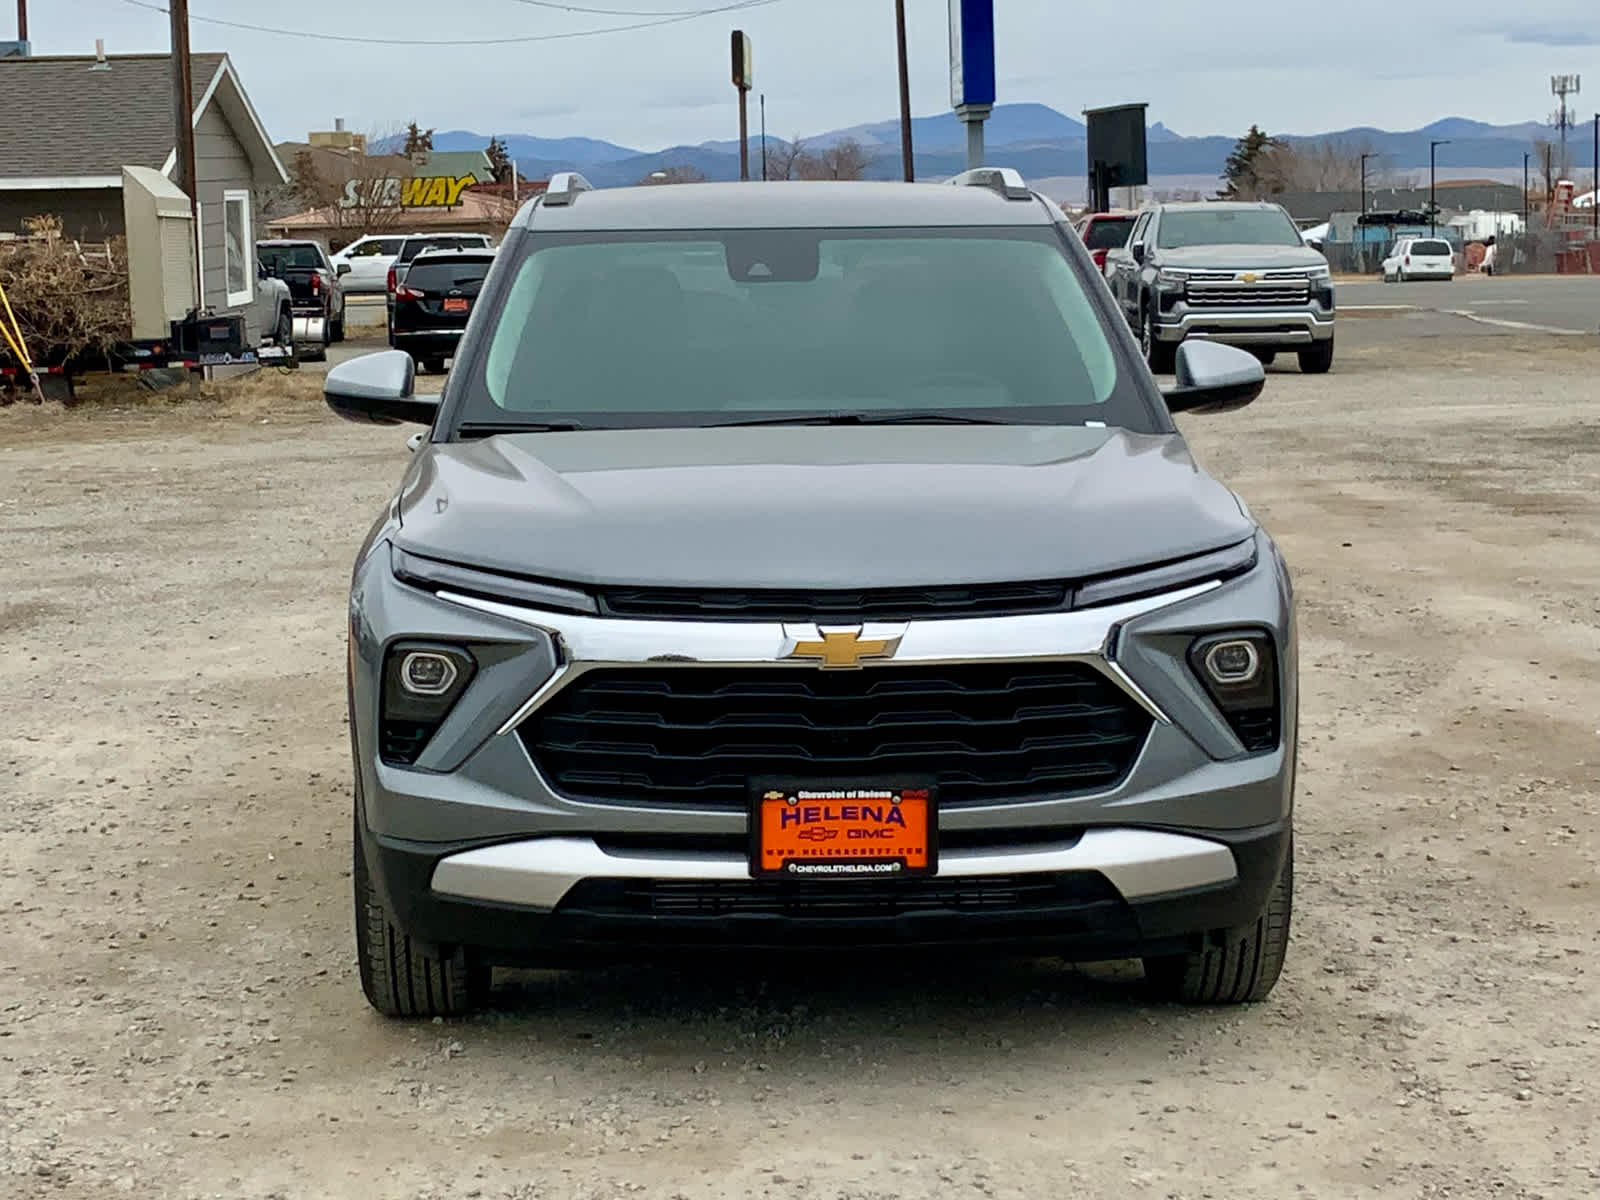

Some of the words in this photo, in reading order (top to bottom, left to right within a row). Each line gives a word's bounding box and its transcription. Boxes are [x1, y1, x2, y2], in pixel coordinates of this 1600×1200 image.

[340, 174, 478, 208] SUBWAY
[780, 806, 907, 829] HELENA
[847, 829, 894, 839] GMC
